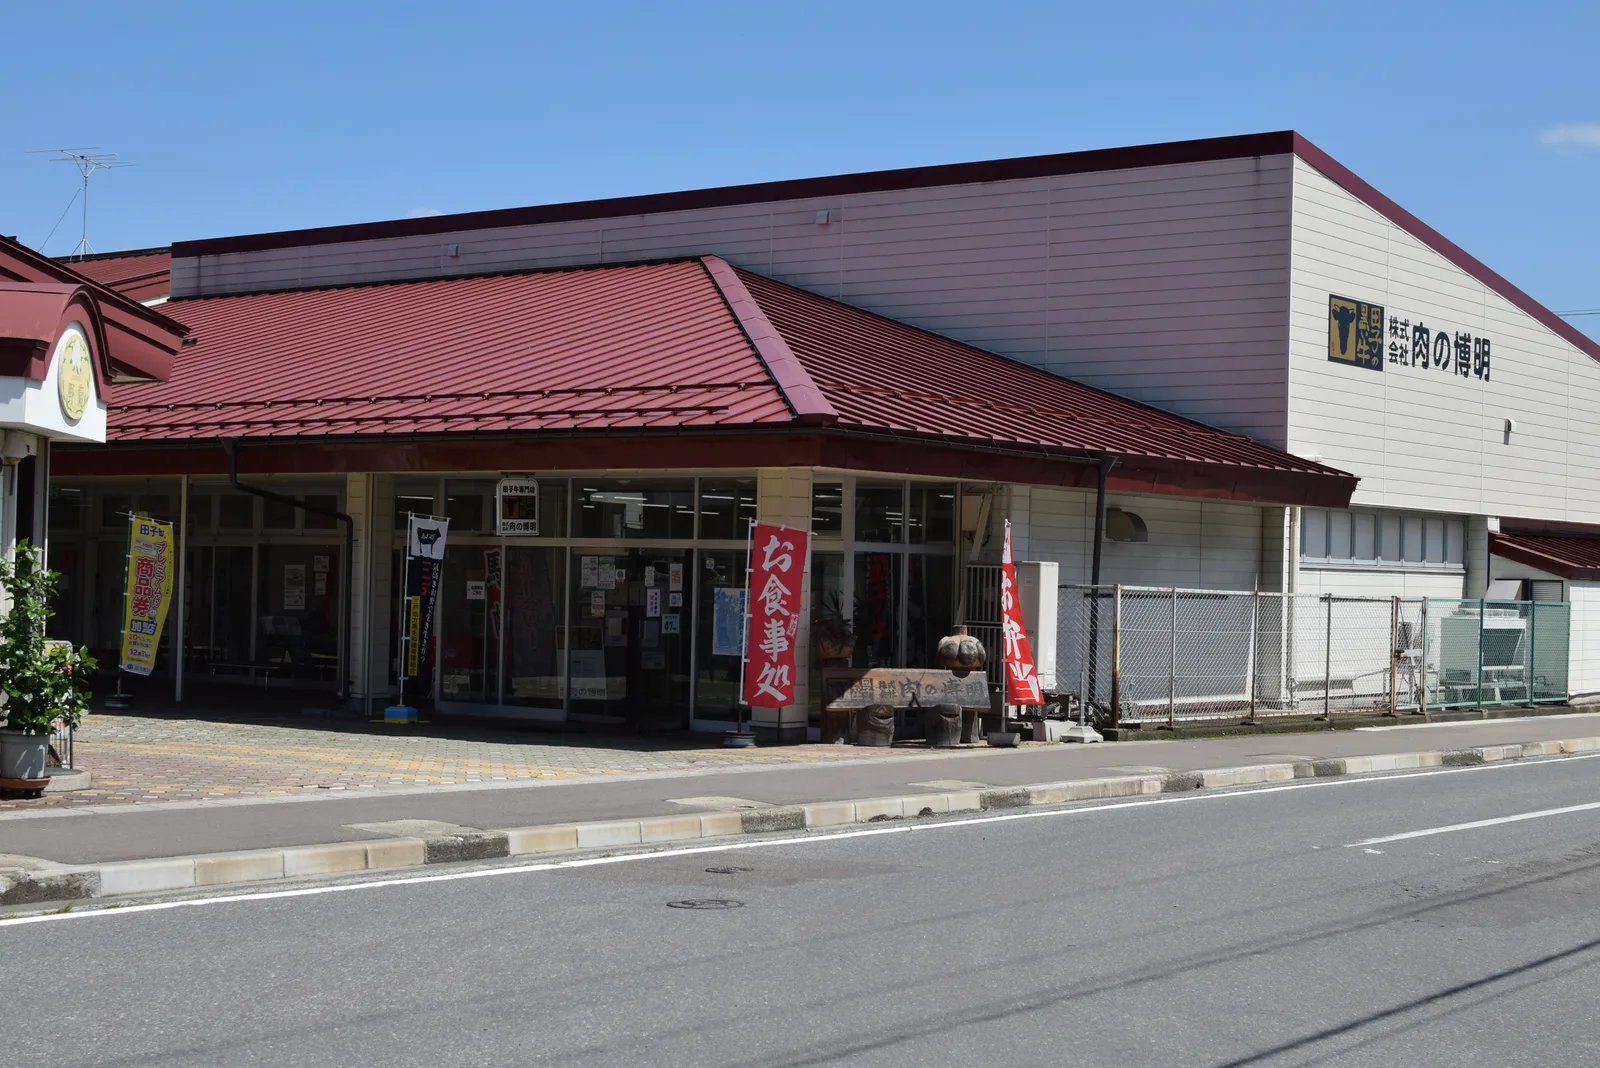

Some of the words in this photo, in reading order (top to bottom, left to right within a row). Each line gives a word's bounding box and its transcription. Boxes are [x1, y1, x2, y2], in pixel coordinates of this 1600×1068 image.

[1412, 322, 1491, 382] 肉の博明
[131, 556, 156, 617] 商品券
[753, 534, 795, 702] お食事処
